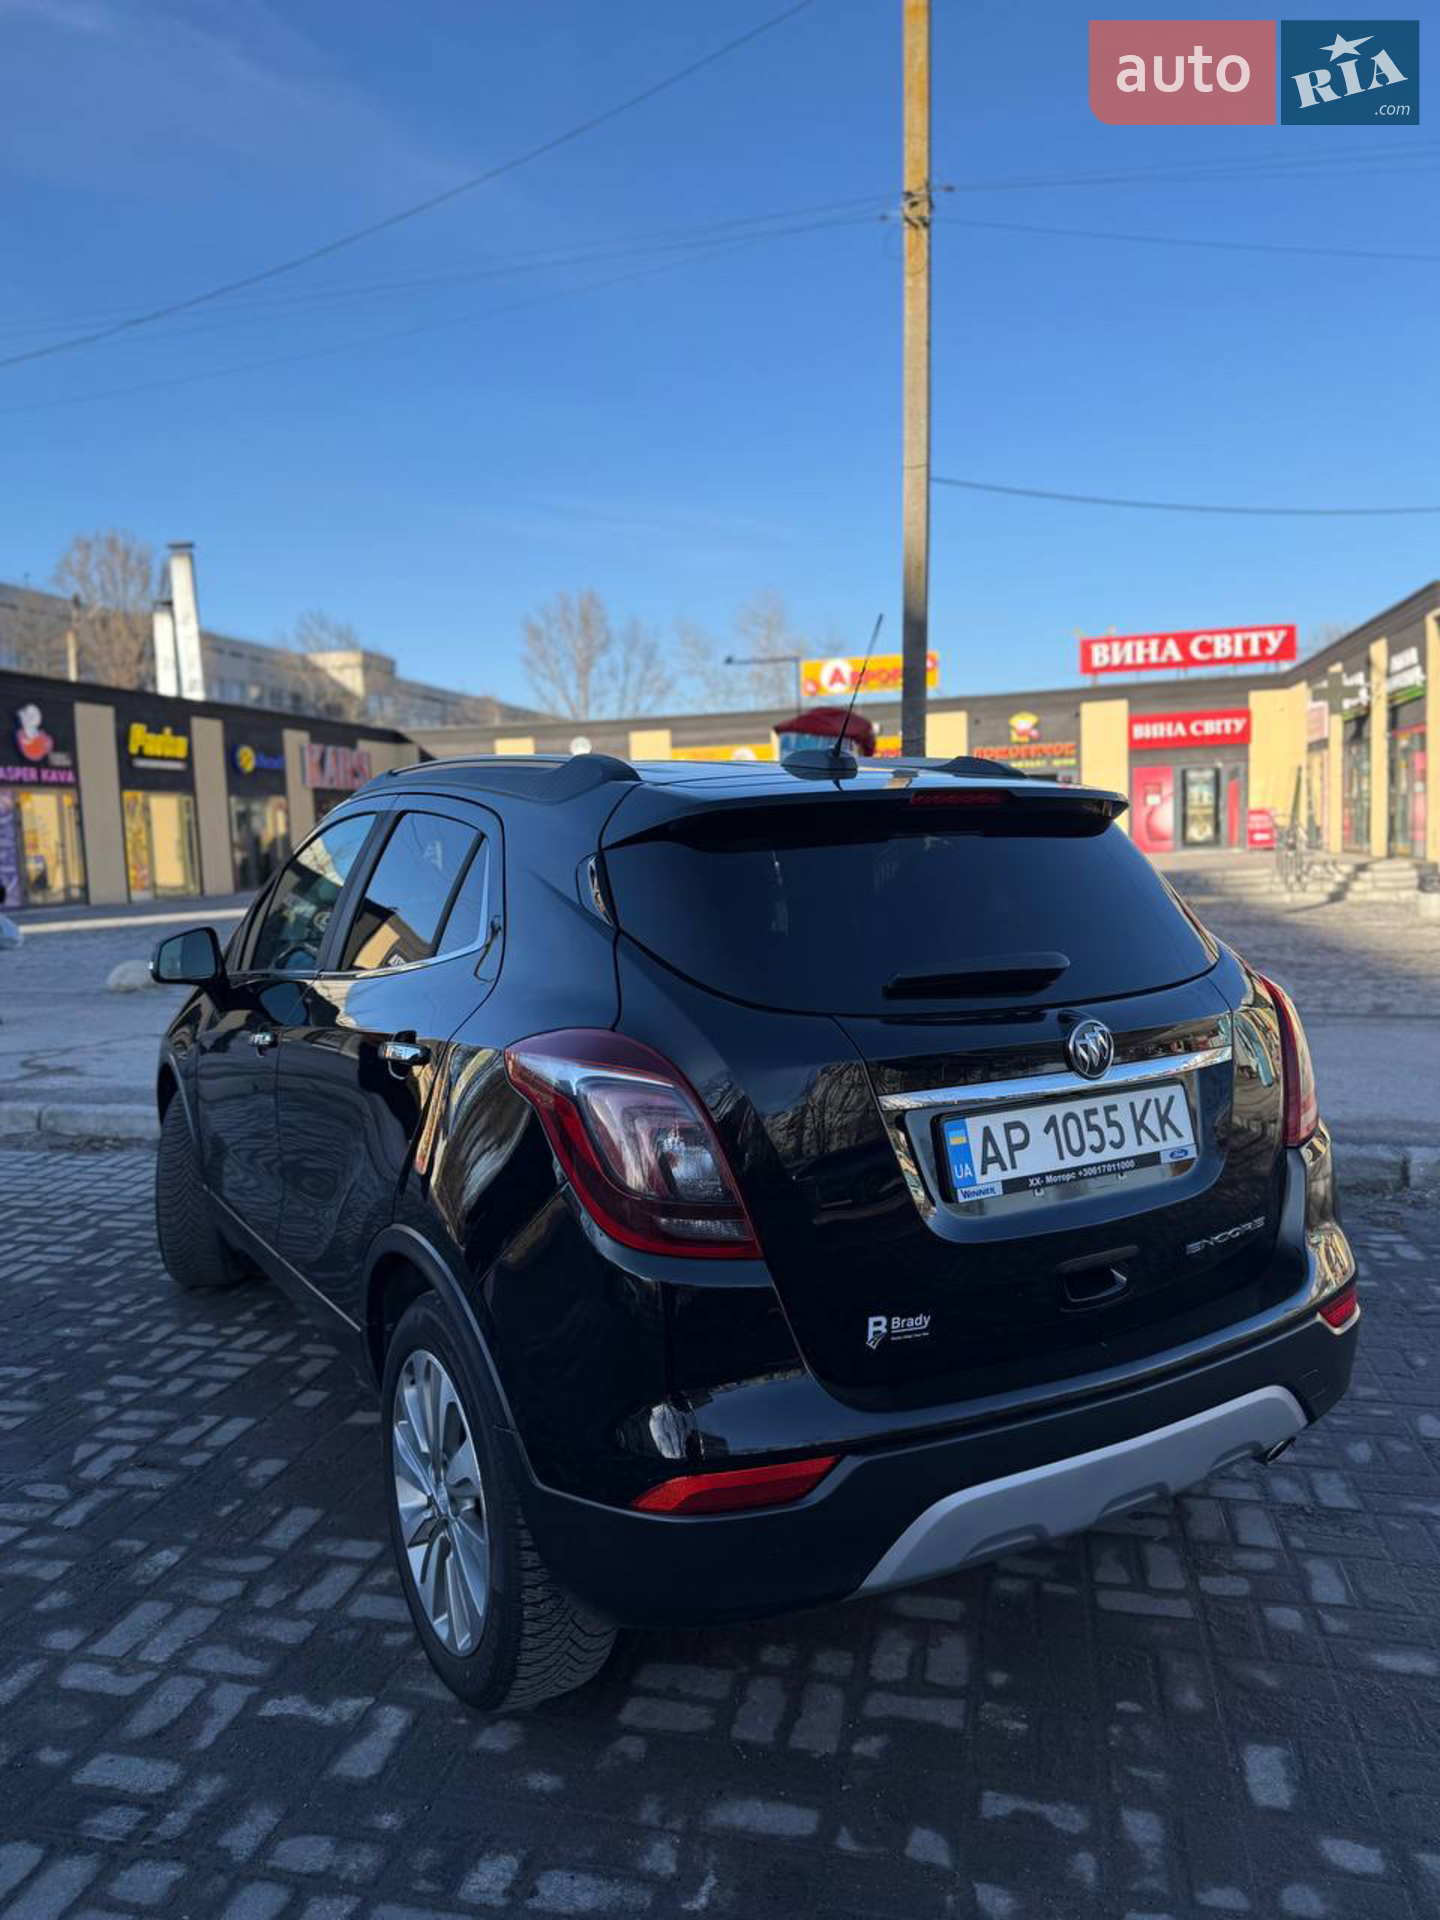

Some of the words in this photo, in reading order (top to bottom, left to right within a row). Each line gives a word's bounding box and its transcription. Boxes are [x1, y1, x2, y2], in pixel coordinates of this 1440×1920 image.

[1090, 638, 1184, 669] ВИНА
[1189, 629, 1288, 660] СВІТУ
[1132, 721, 1187, 740] ВИНА
[1190, 717, 1247, 737] СВІТУ
[980, 1120, 1031, 1176] AP
[1043, 1103, 1126, 1161] 1055
[1129, 1094, 1184, 1147] KK
[953, 1164, 974, 1179] UA
[891, 1313, 931, 1330] Brady
